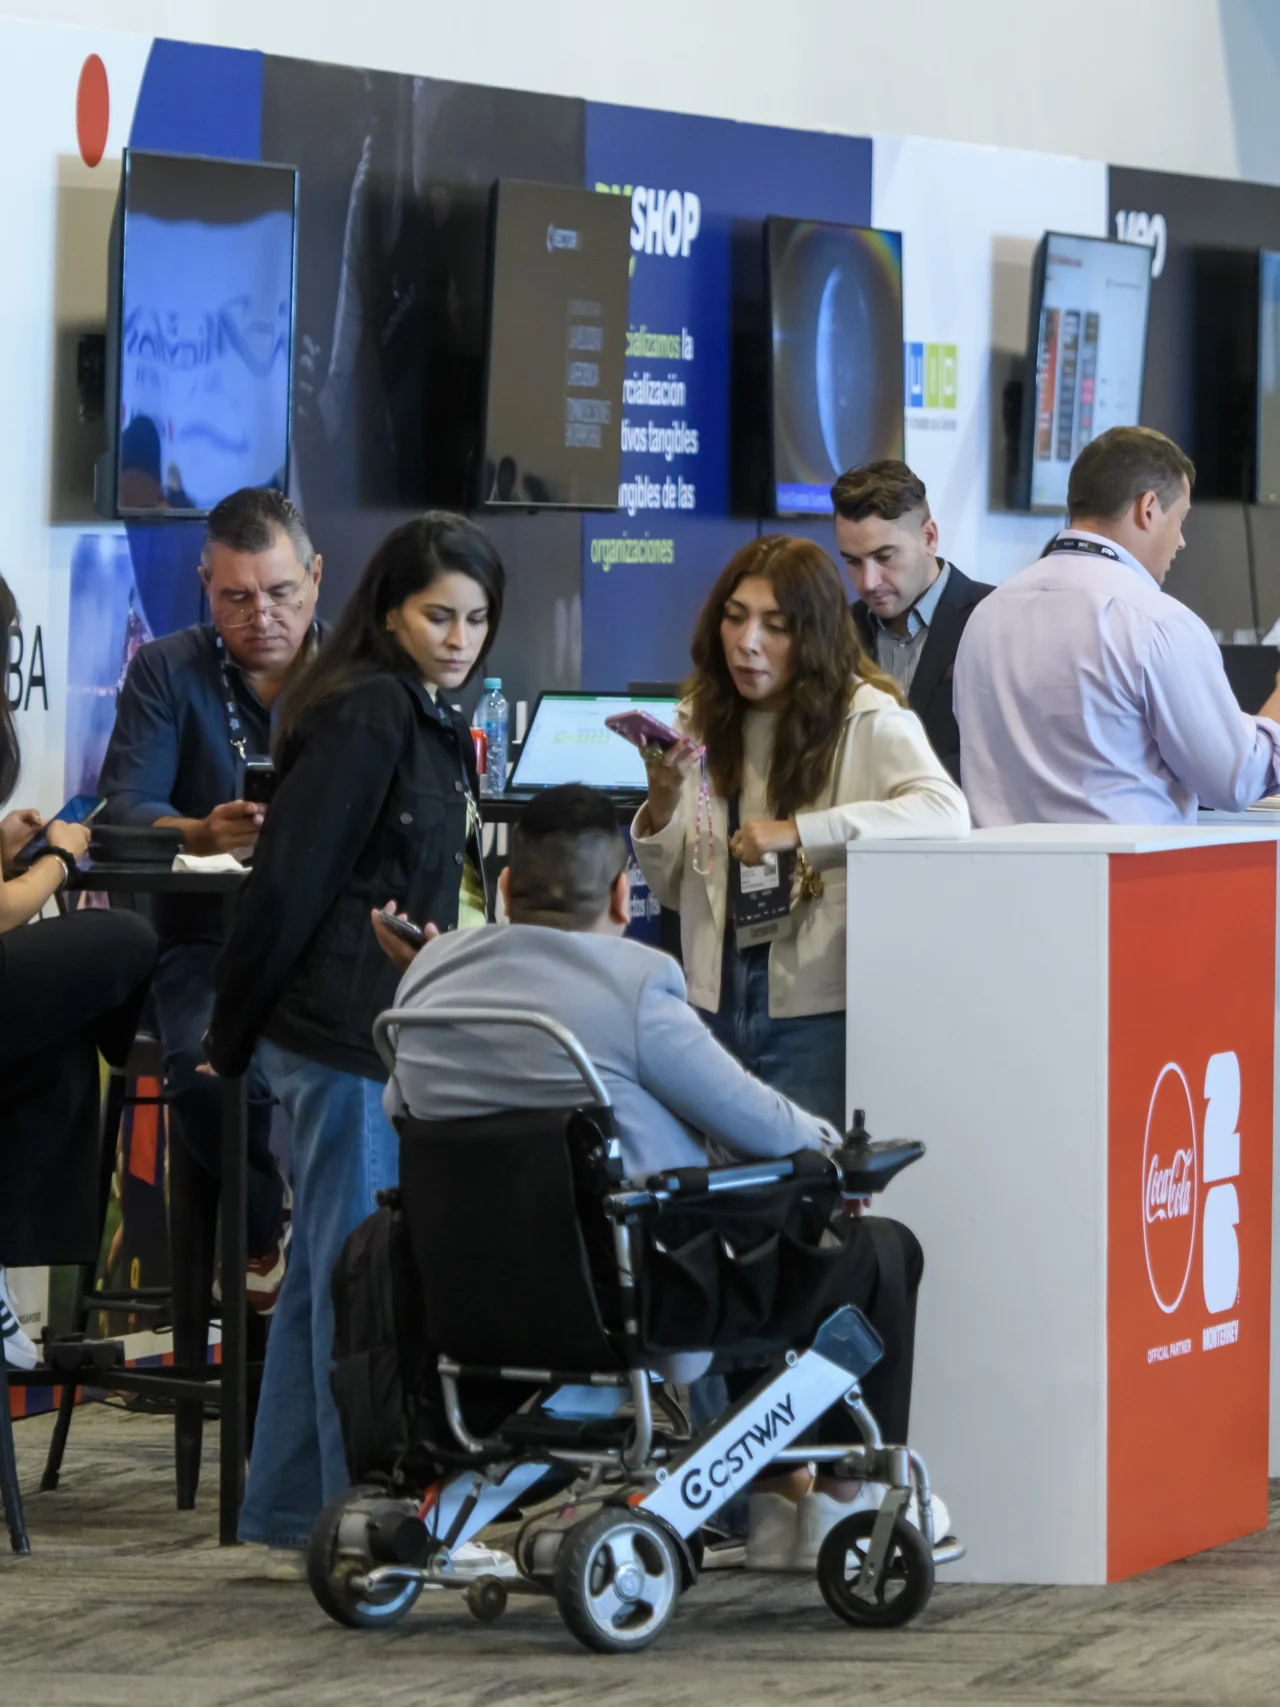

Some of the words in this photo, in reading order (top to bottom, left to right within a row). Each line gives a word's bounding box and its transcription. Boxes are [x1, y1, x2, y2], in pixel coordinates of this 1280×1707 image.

[630, 185, 702, 258] SHOP
[681, 326, 694, 360] la
[648, 420, 700, 462] tangibles
[661, 475, 677, 509] de
[678, 475, 696, 510] las
[590, 530, 675, 573] organizaciones
[1147, 1345, 1170, 1365] OFFICIAL
[1169, 1338, 1192, 1358] PARTNER
[1202, 1319, 1239, 1352] MONTERREY
